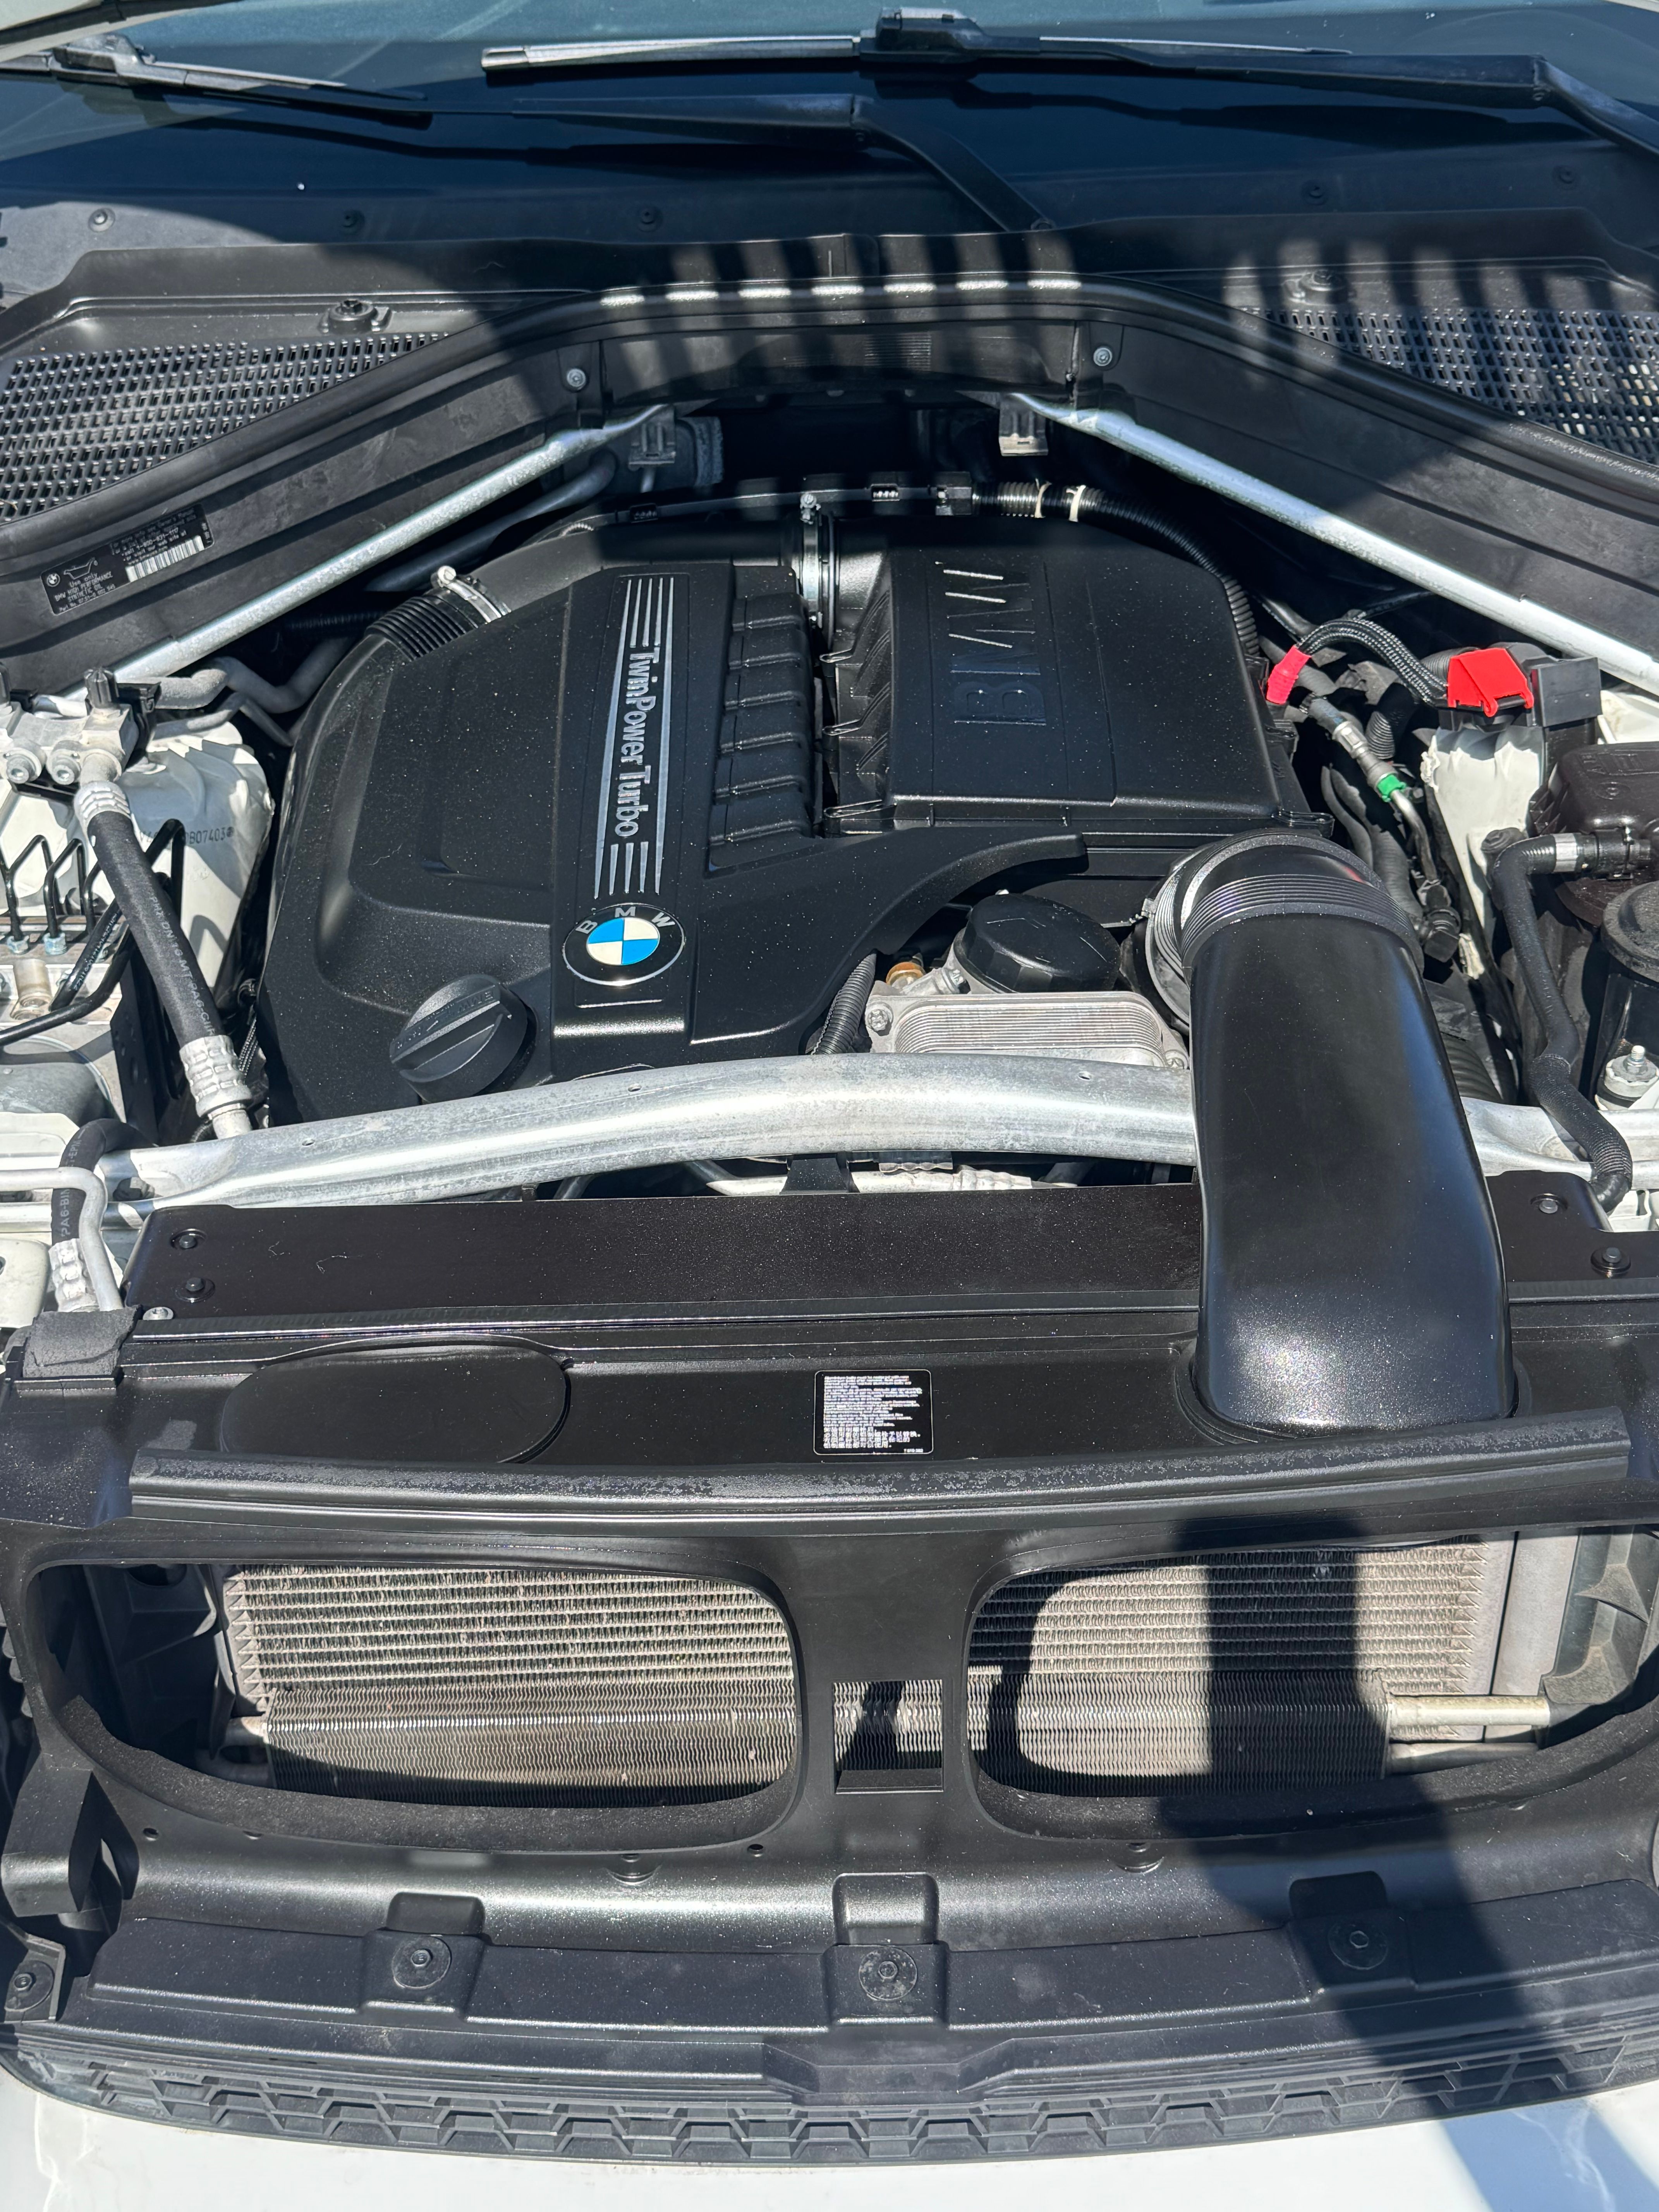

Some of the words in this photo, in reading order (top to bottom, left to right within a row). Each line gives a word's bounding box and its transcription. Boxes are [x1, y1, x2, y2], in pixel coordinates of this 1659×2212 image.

[84, 573, 98, 582] only
[939, 565, 1046, 725] BMW
[620, 647, 660, 765] TwinPower
[615, 765, 651, 836] Turbo
[575, 907, 675, 934] BMW
